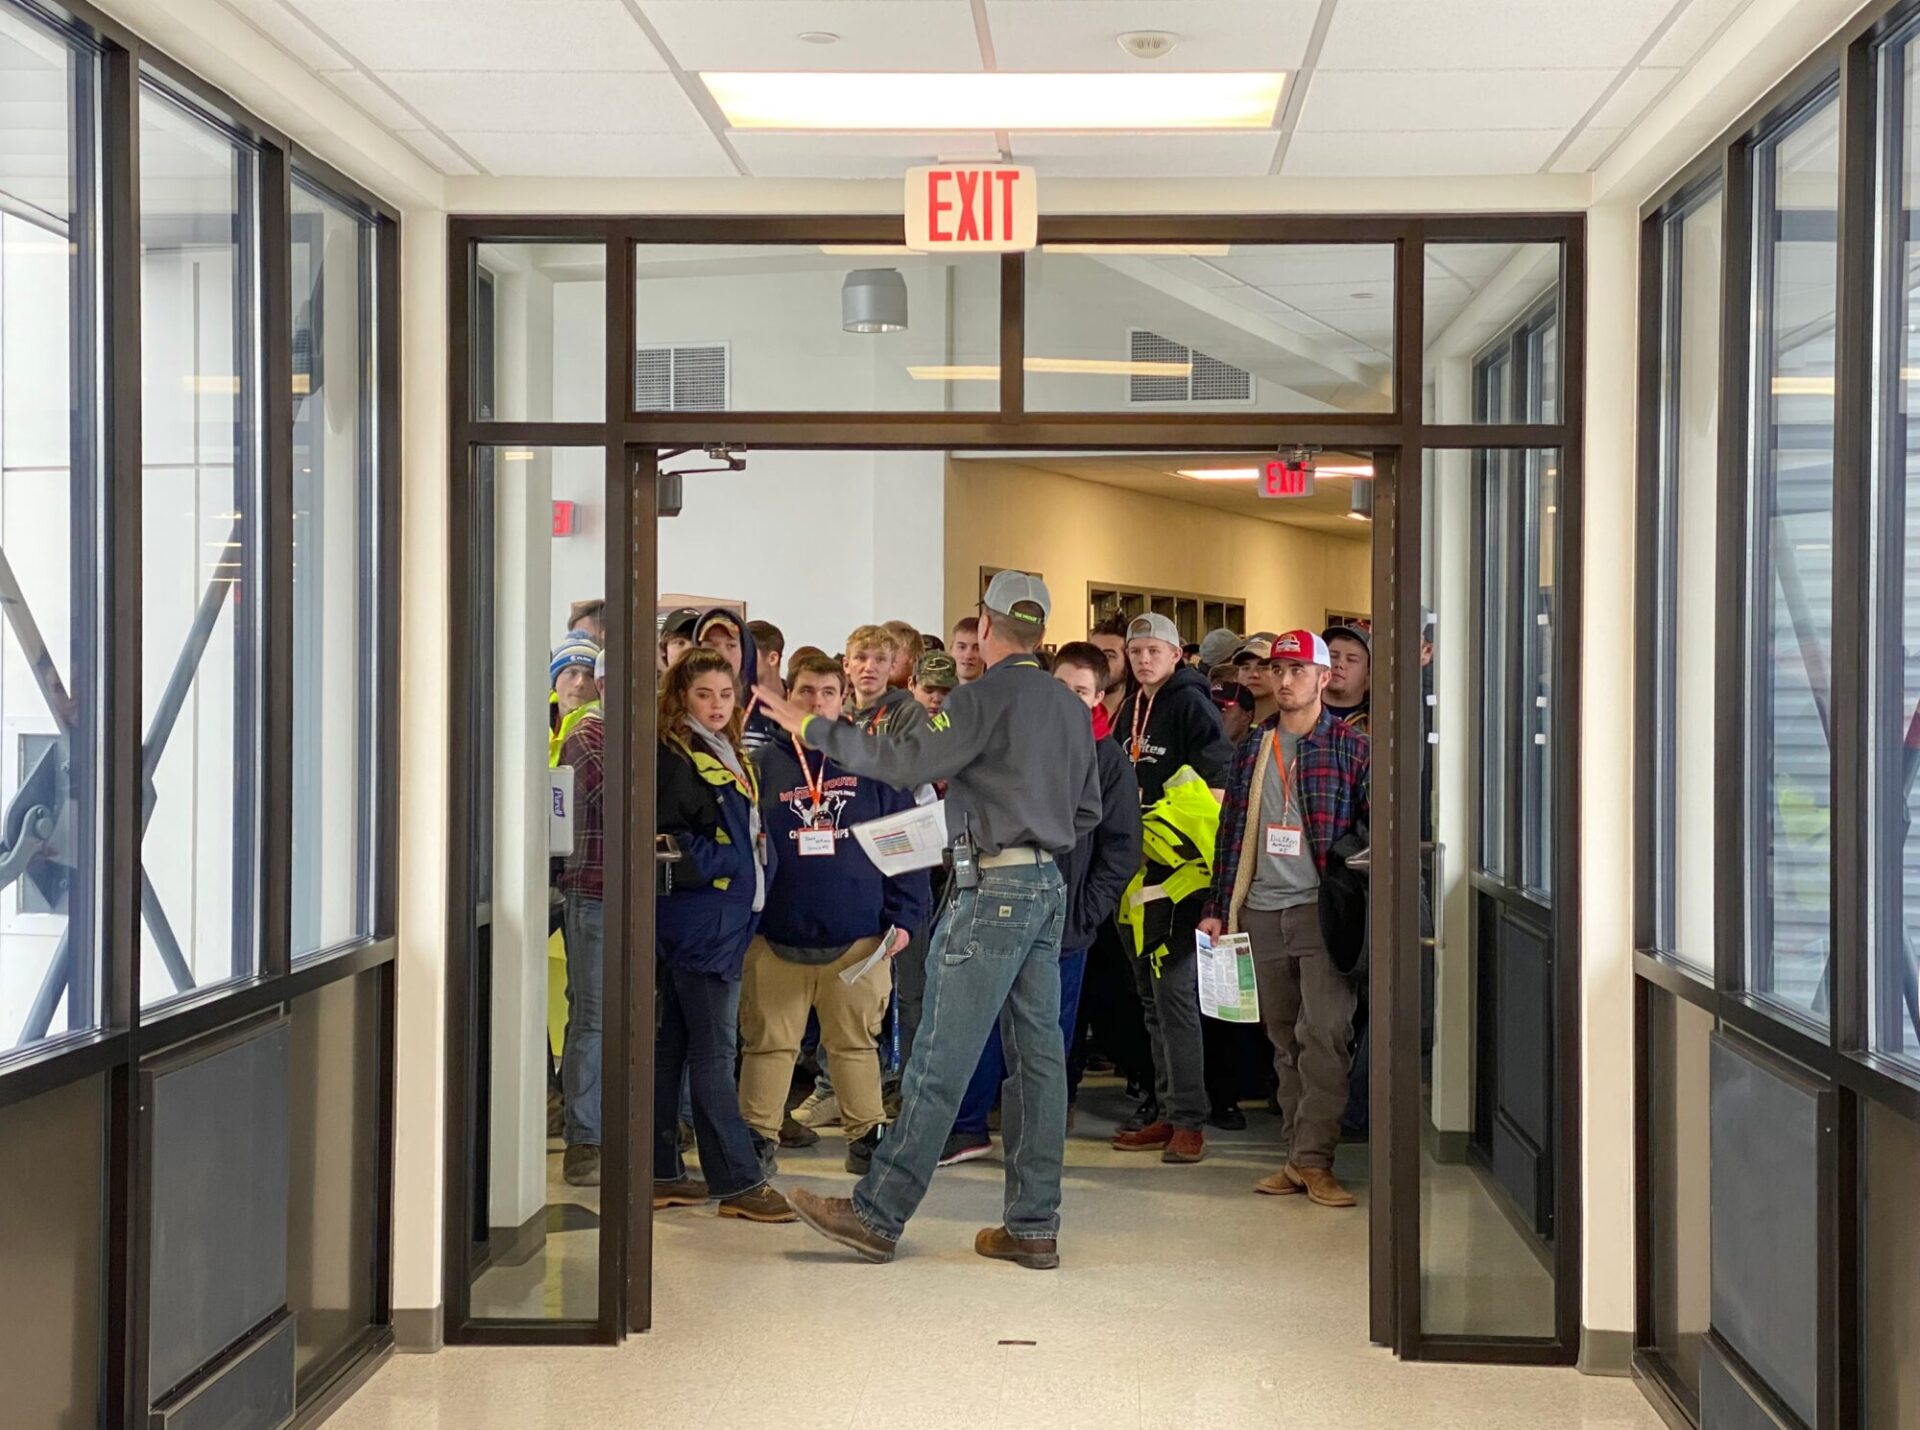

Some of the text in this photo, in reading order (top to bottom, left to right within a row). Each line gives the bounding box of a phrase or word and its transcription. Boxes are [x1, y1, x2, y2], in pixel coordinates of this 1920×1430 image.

[928, 170, 1020, 241] EXIT
[1266, 460, 1309, 495] EXIT
[823, 776, 858, 790] YOUTH
